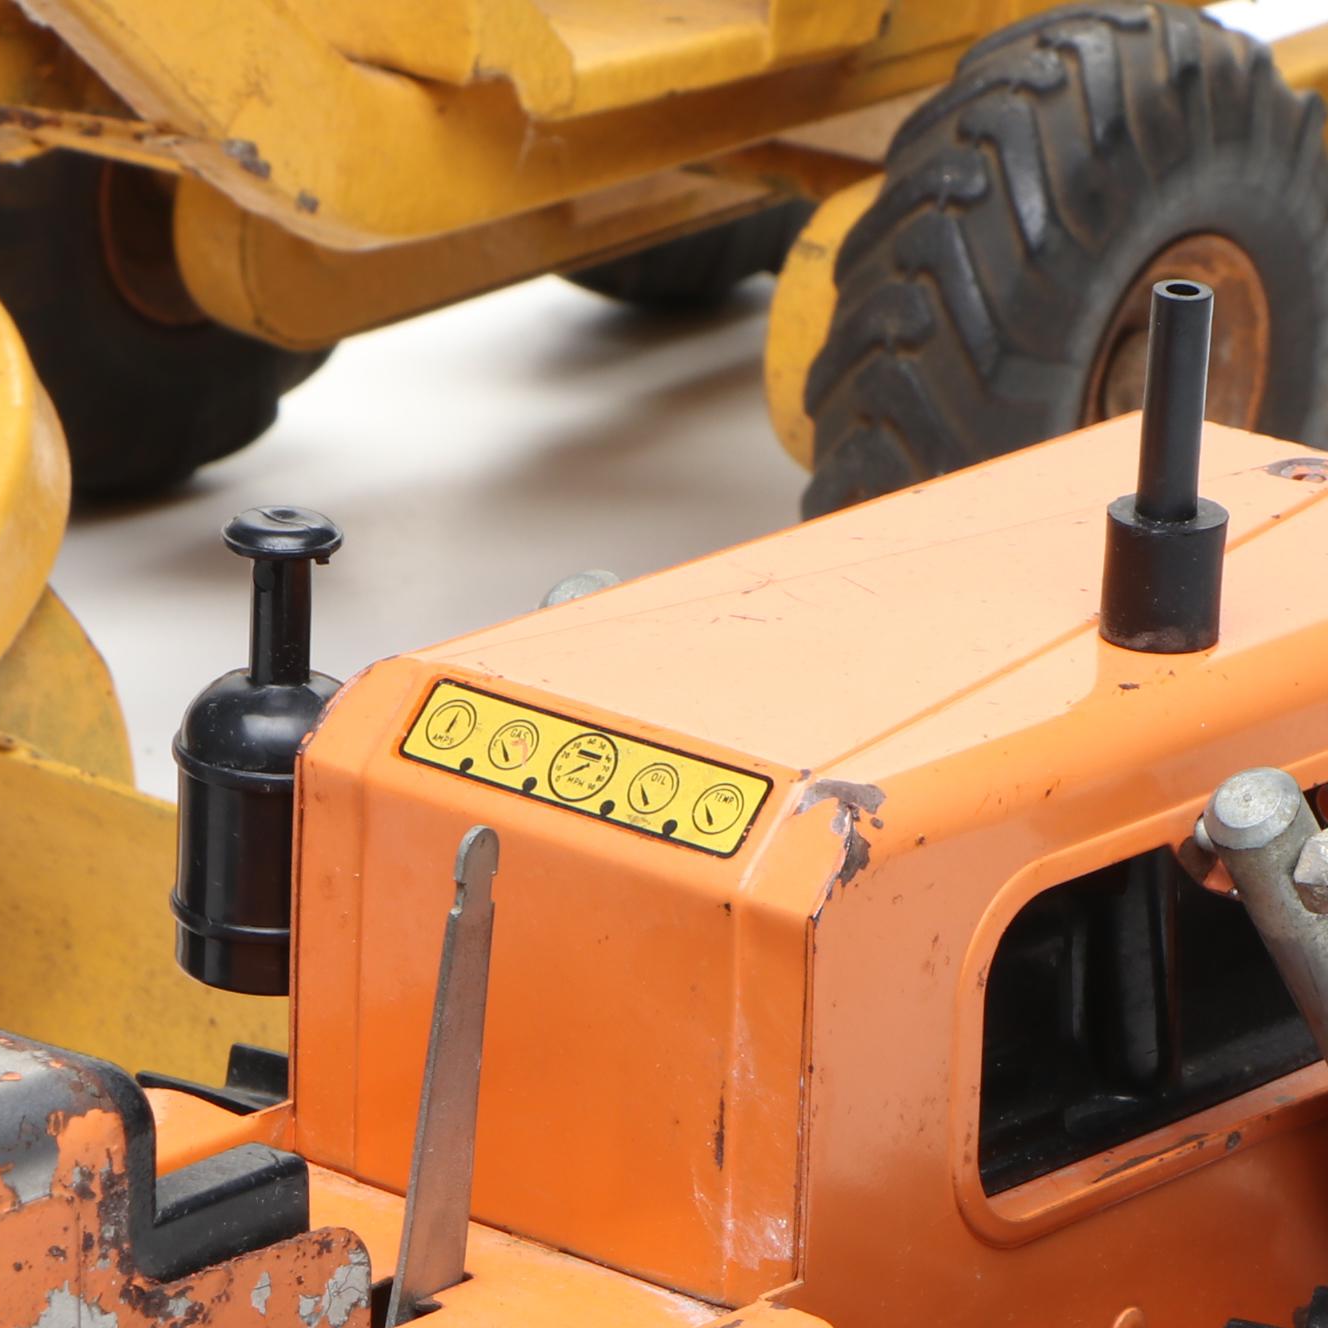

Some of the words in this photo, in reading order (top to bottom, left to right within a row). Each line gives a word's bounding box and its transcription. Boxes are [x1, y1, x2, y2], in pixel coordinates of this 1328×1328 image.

[432, 733, 454, 746] AMPS
[510, 729, 529, 740] GAS
[651, 772, 667, 786] OIL
